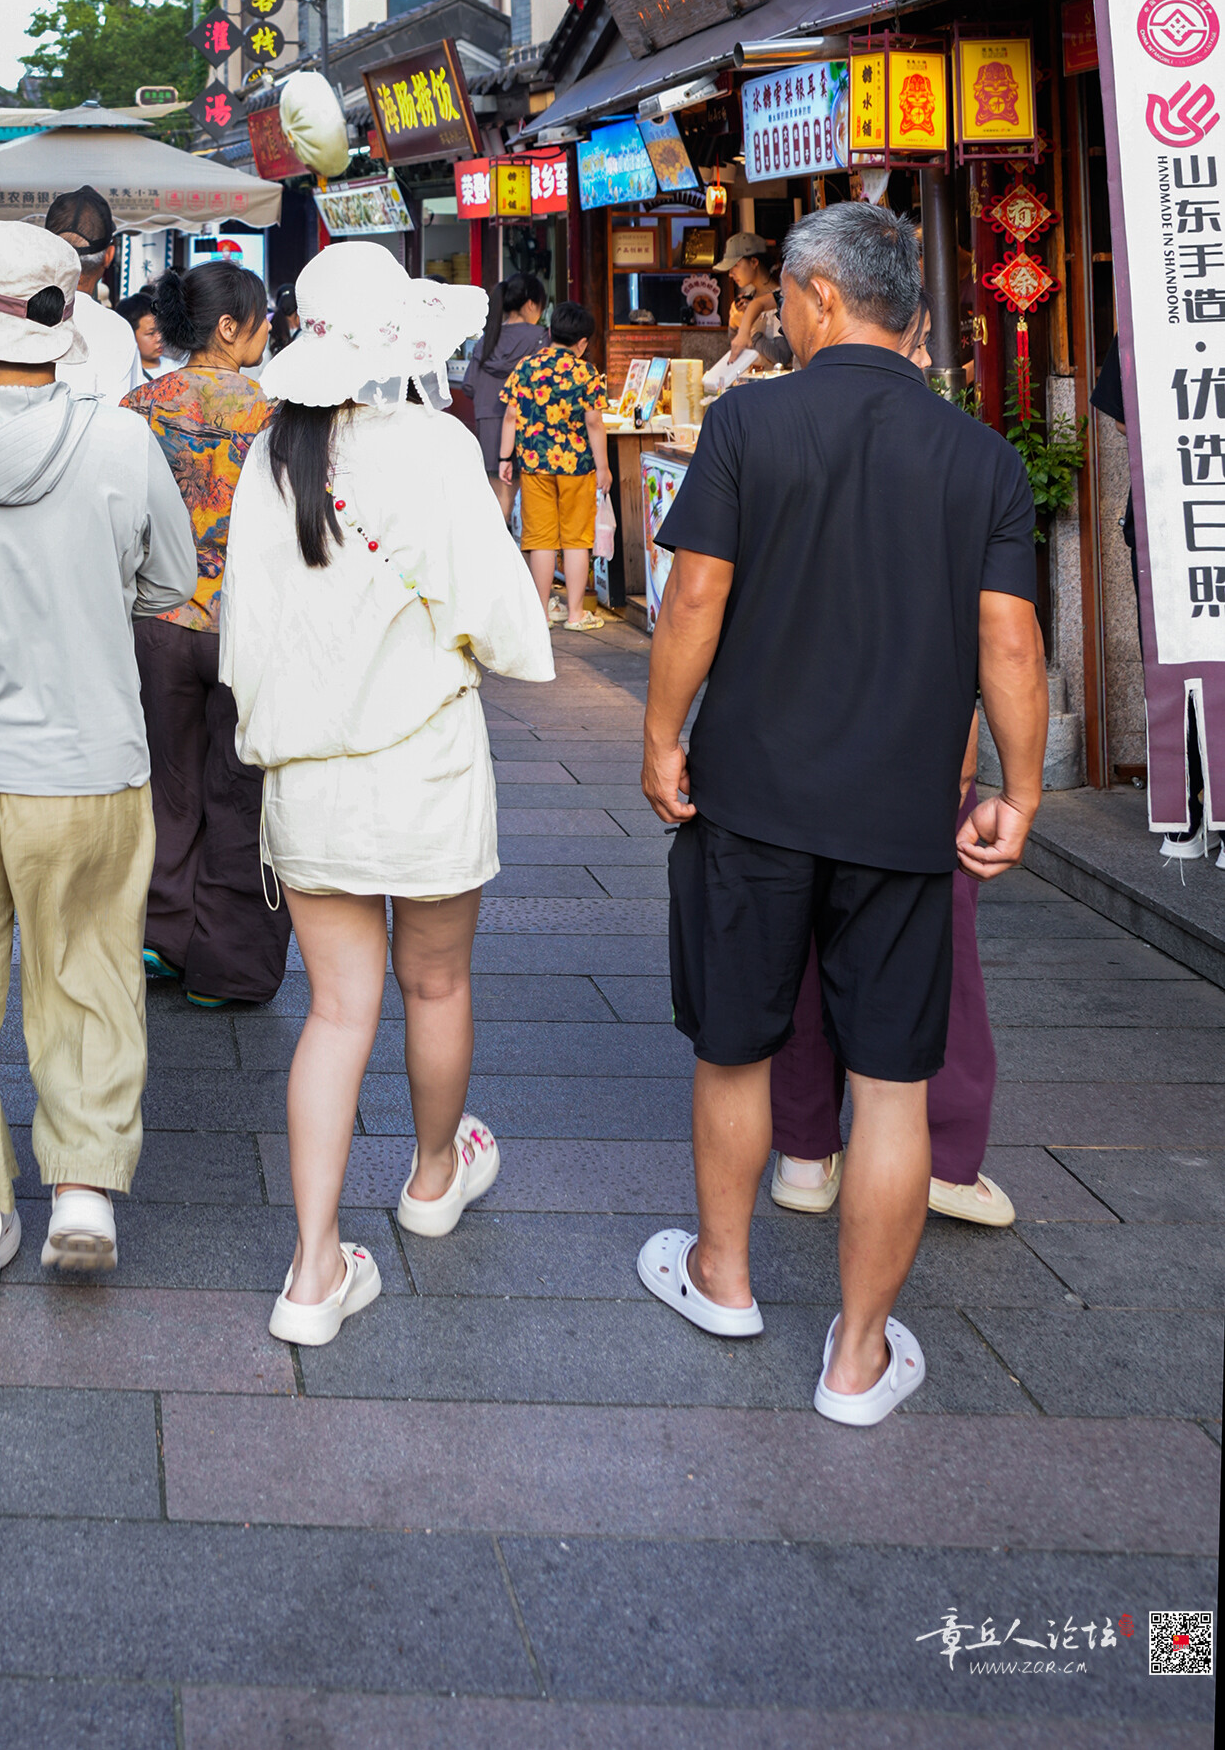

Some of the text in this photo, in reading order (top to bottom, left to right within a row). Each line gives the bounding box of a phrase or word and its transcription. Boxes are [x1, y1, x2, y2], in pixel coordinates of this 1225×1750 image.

[377, 66, 461, 135] 海肠捞饭
[1157, 155, 1181, 325] HANDMADE IN SHANDONG
